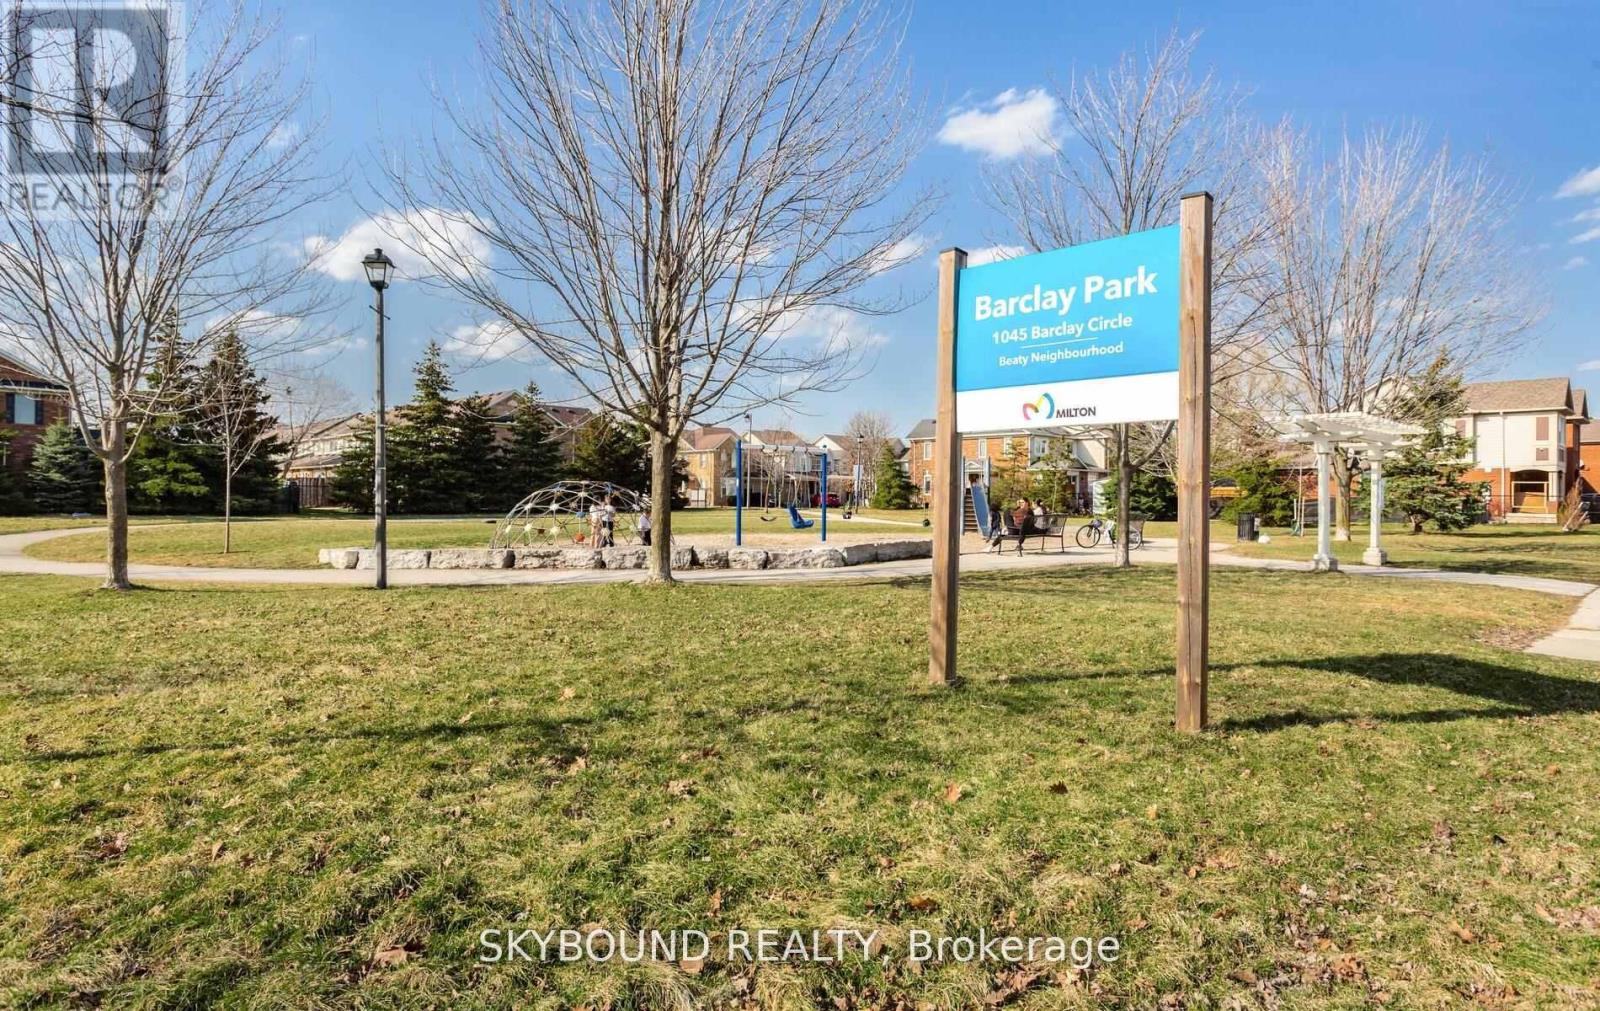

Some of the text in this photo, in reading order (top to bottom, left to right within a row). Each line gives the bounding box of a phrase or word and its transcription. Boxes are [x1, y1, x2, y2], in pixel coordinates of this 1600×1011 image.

[974, 265, 1158, 321] Barclay Park
[992, 313, 1133, 344] 1045 Barclay Circle
[999, 342, 1124, 367] Beaty Neighbourhood
[1055, 406, 1097, 418] MILTON
